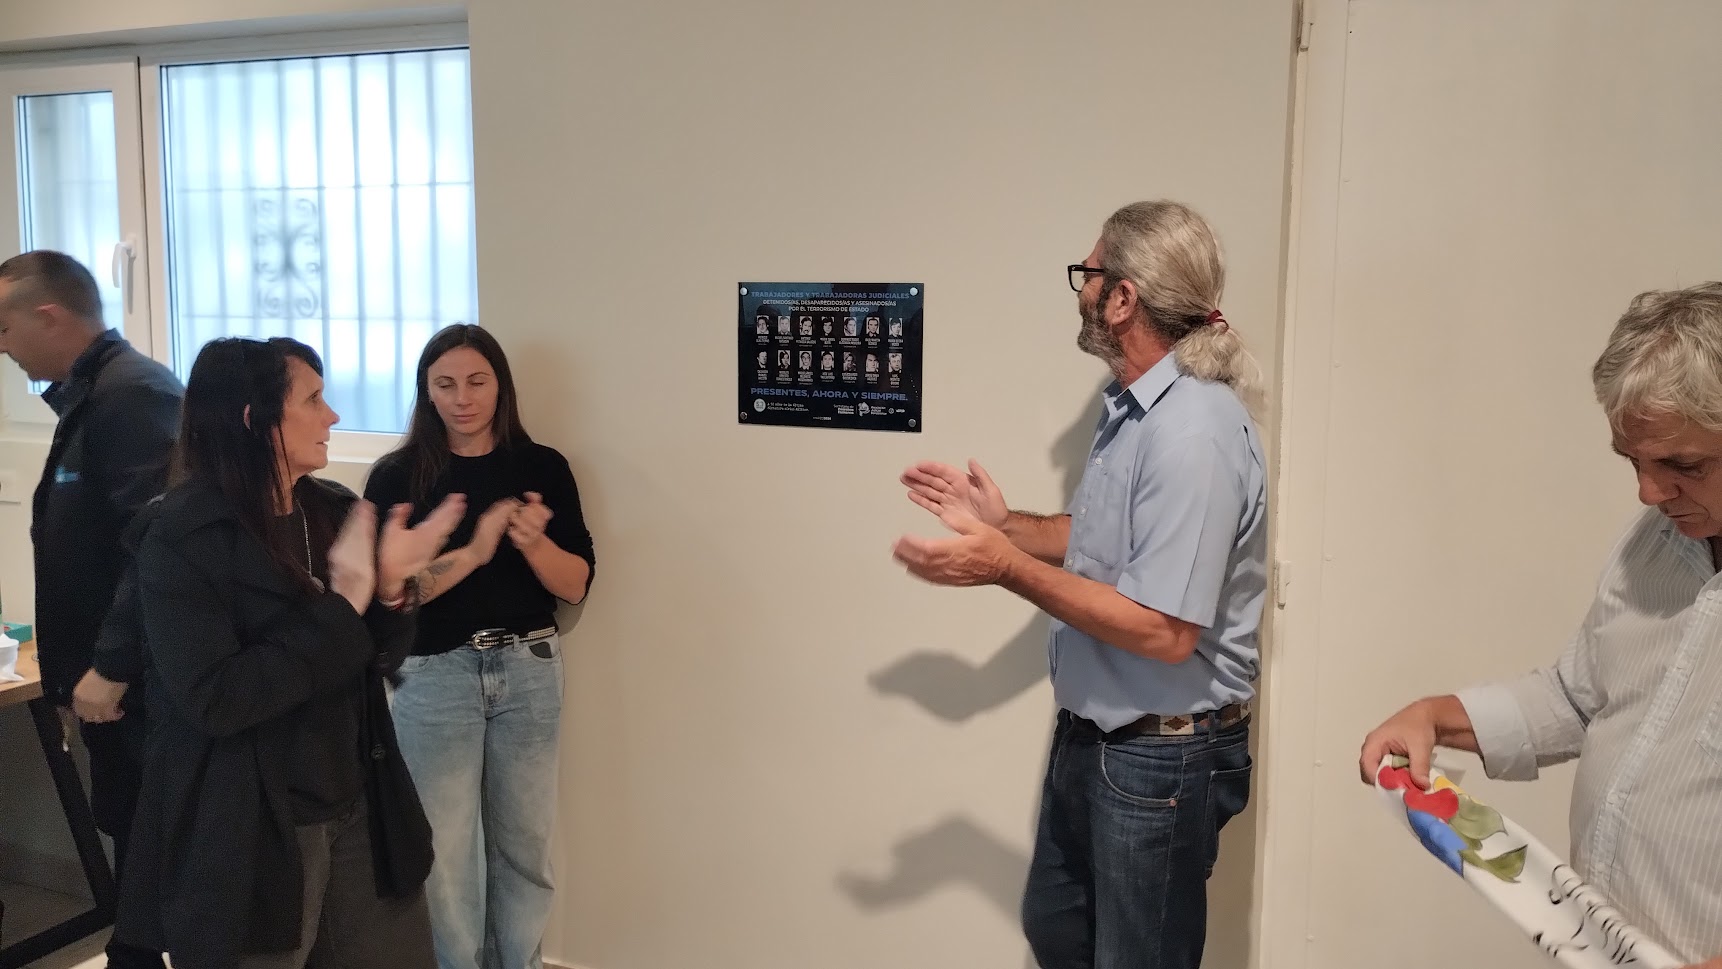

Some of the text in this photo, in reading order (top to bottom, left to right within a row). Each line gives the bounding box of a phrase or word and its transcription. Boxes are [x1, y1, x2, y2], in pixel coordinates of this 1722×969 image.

[750, 387, 909, 401] PRESENTES, AHORA Y SIEMPRE.
